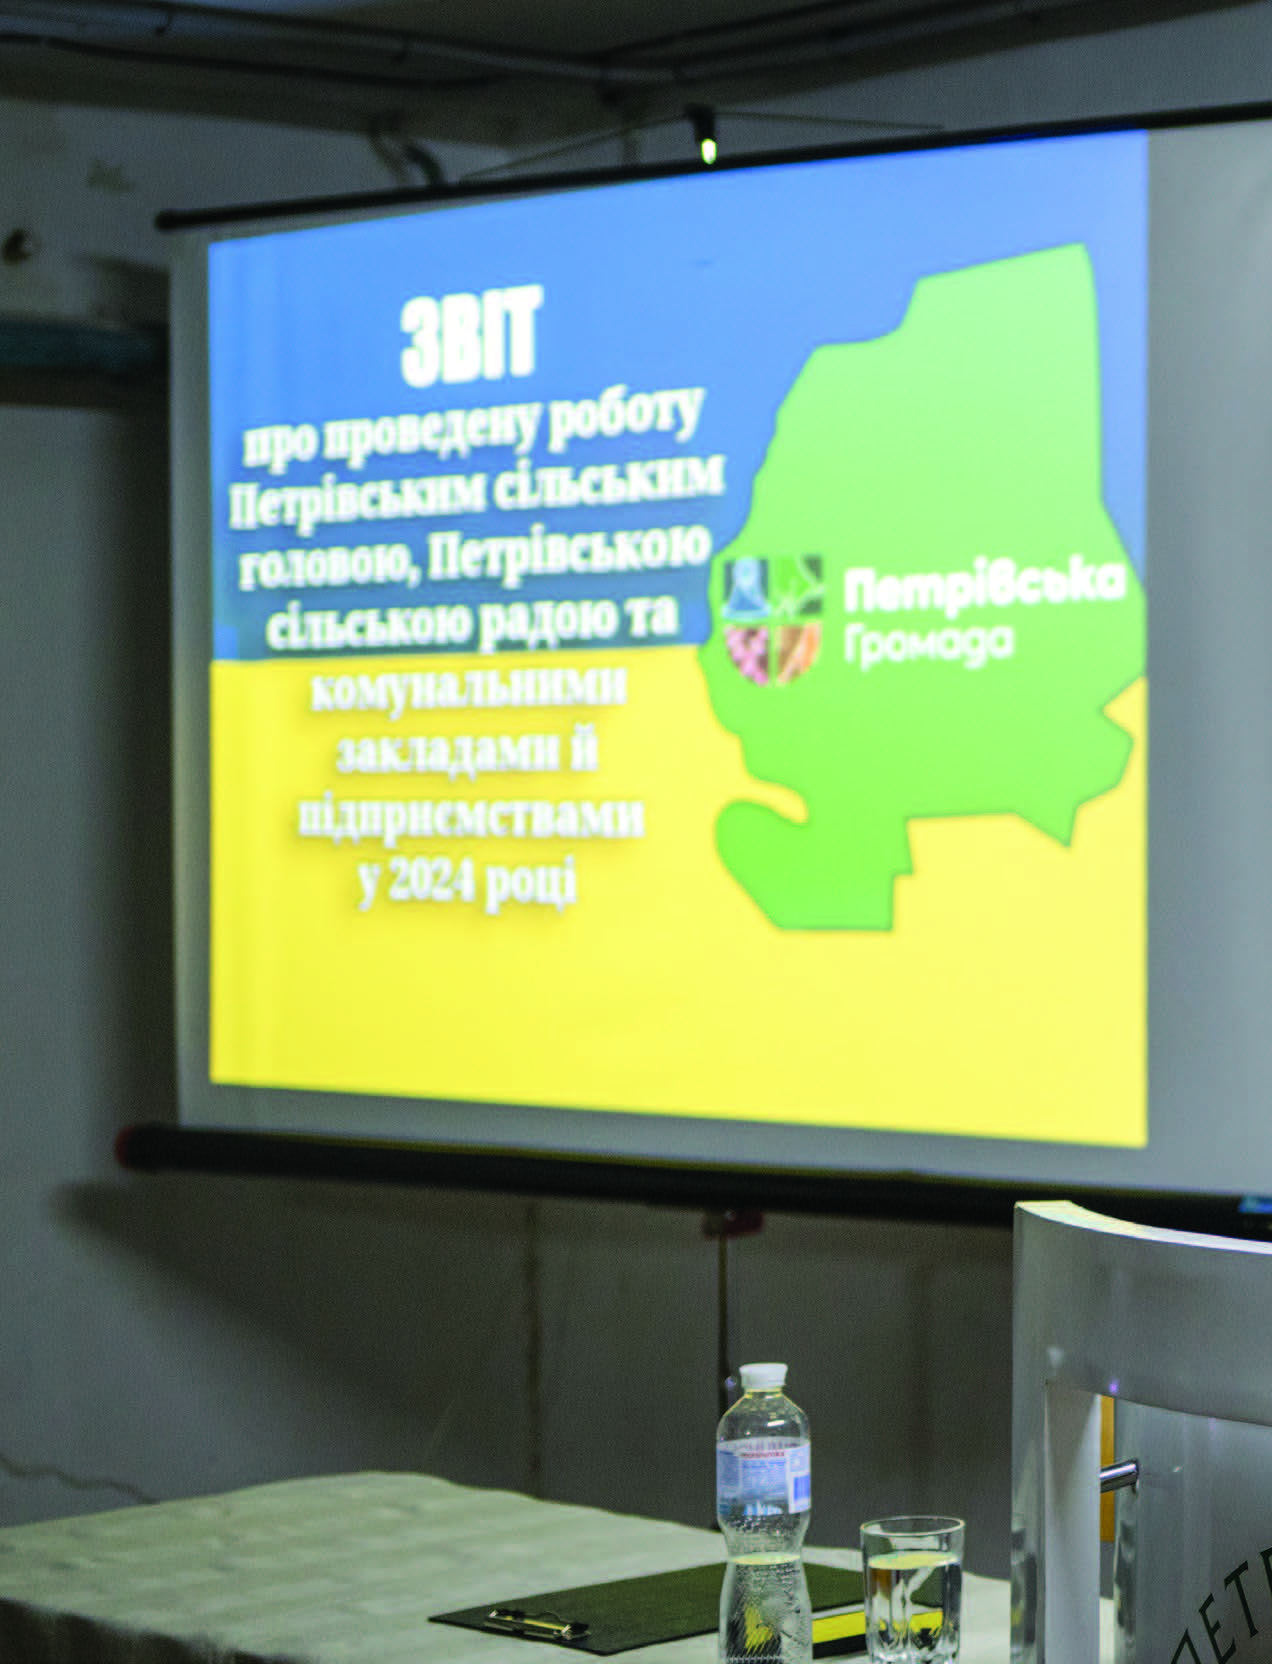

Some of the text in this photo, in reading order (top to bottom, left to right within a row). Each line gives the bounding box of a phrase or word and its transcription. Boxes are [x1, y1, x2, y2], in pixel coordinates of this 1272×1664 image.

[401, 284, 544, 388] ЗВІТ
[243, 383, 705, 474] про проведену роботу
[229, 453, 725, 537] Петрівським сільським
[239, 523, 712, 591] головою, Петрівською
[844, 555, 1127, 620] Петрівська
[266, 596, 678, 653] сільською радою та
[844, 623, 1014, 672] Громада
[311, 667, 628, 721] комунальними
[336, 723, 599, 781] закладами й
[299, 791, 645, 848] підприємствами
[357, 855, 577, 915] у 2024 році
